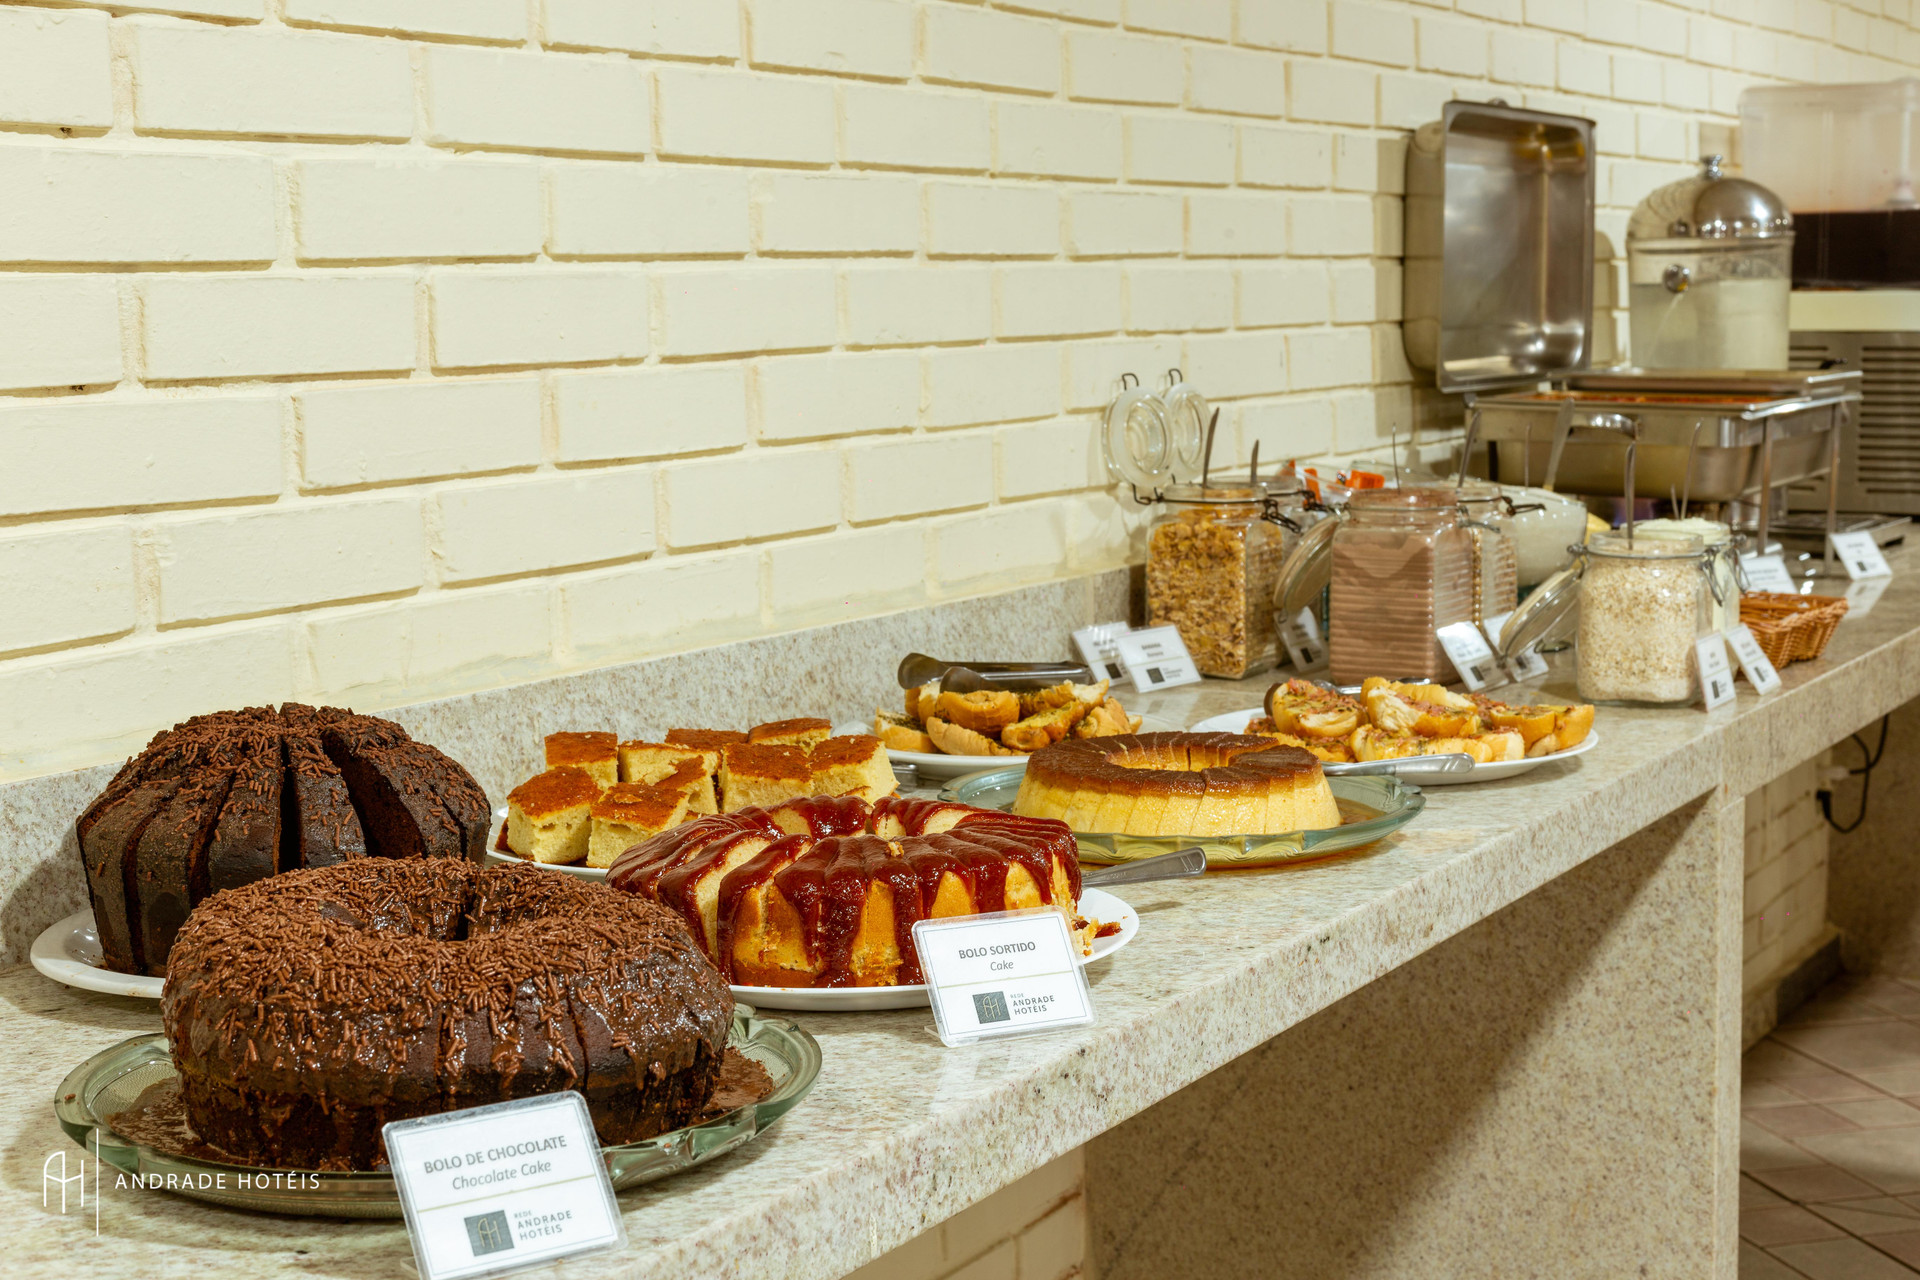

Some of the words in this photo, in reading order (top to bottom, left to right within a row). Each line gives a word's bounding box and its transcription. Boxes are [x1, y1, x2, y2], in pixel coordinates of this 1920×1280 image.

[958, 947, 988, 959] BOLO
[989, 941, 1036, 956] SORTIDO
[990, 960, 1014, 971] Cake
[1012, 995, 1055, 1007] ANDRADE
[1014, 1004, 1048, 1016] HOTÉIS
[423, 1156, 462, 1174] BOLO
[465, 1152, 485, 1166] DE
[487, 1135, 567, 1162] CHOCOLATE
[452, 1171, 517, 1190] Chocolate
[520, 1160, 552, 1176] Cake
[514, 1210, 532, 1219] REDE
[517, 1210, 573, 1229] ANDRADE
[520, 1224, 563, 1241] HOTÉIS
